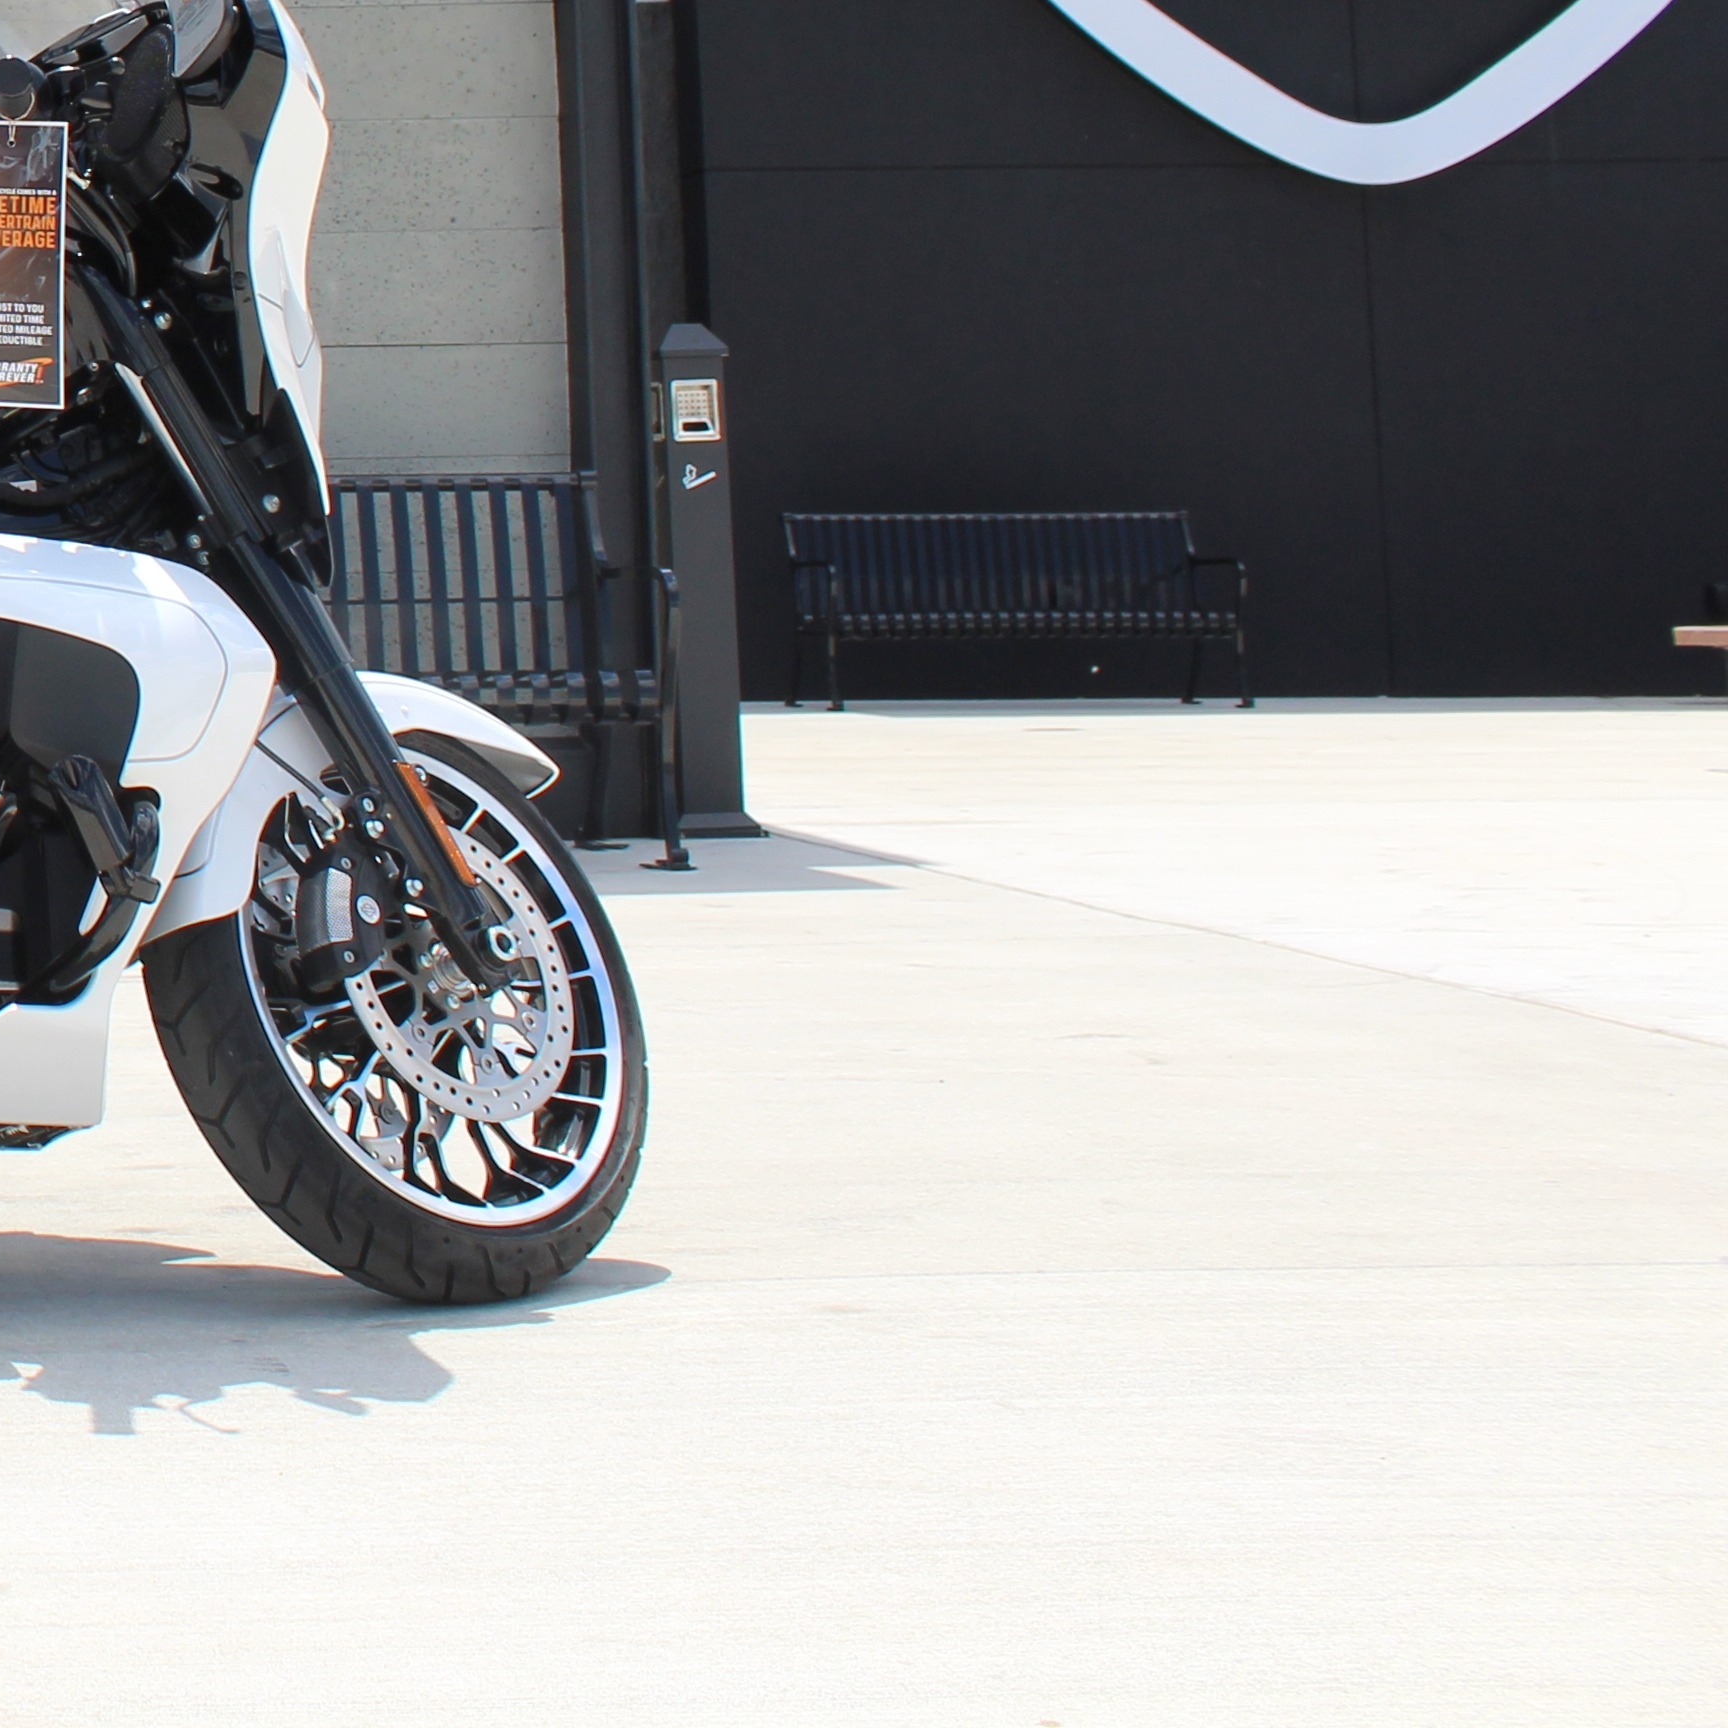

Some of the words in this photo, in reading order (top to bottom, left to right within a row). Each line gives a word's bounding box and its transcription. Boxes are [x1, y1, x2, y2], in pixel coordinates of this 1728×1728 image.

[14, 303, 25, 313] TO
[26, 303, 44, 314] YOU
[23, 314, 44, 325] TIME
[15, 324, 53, 336] MILEAGE
